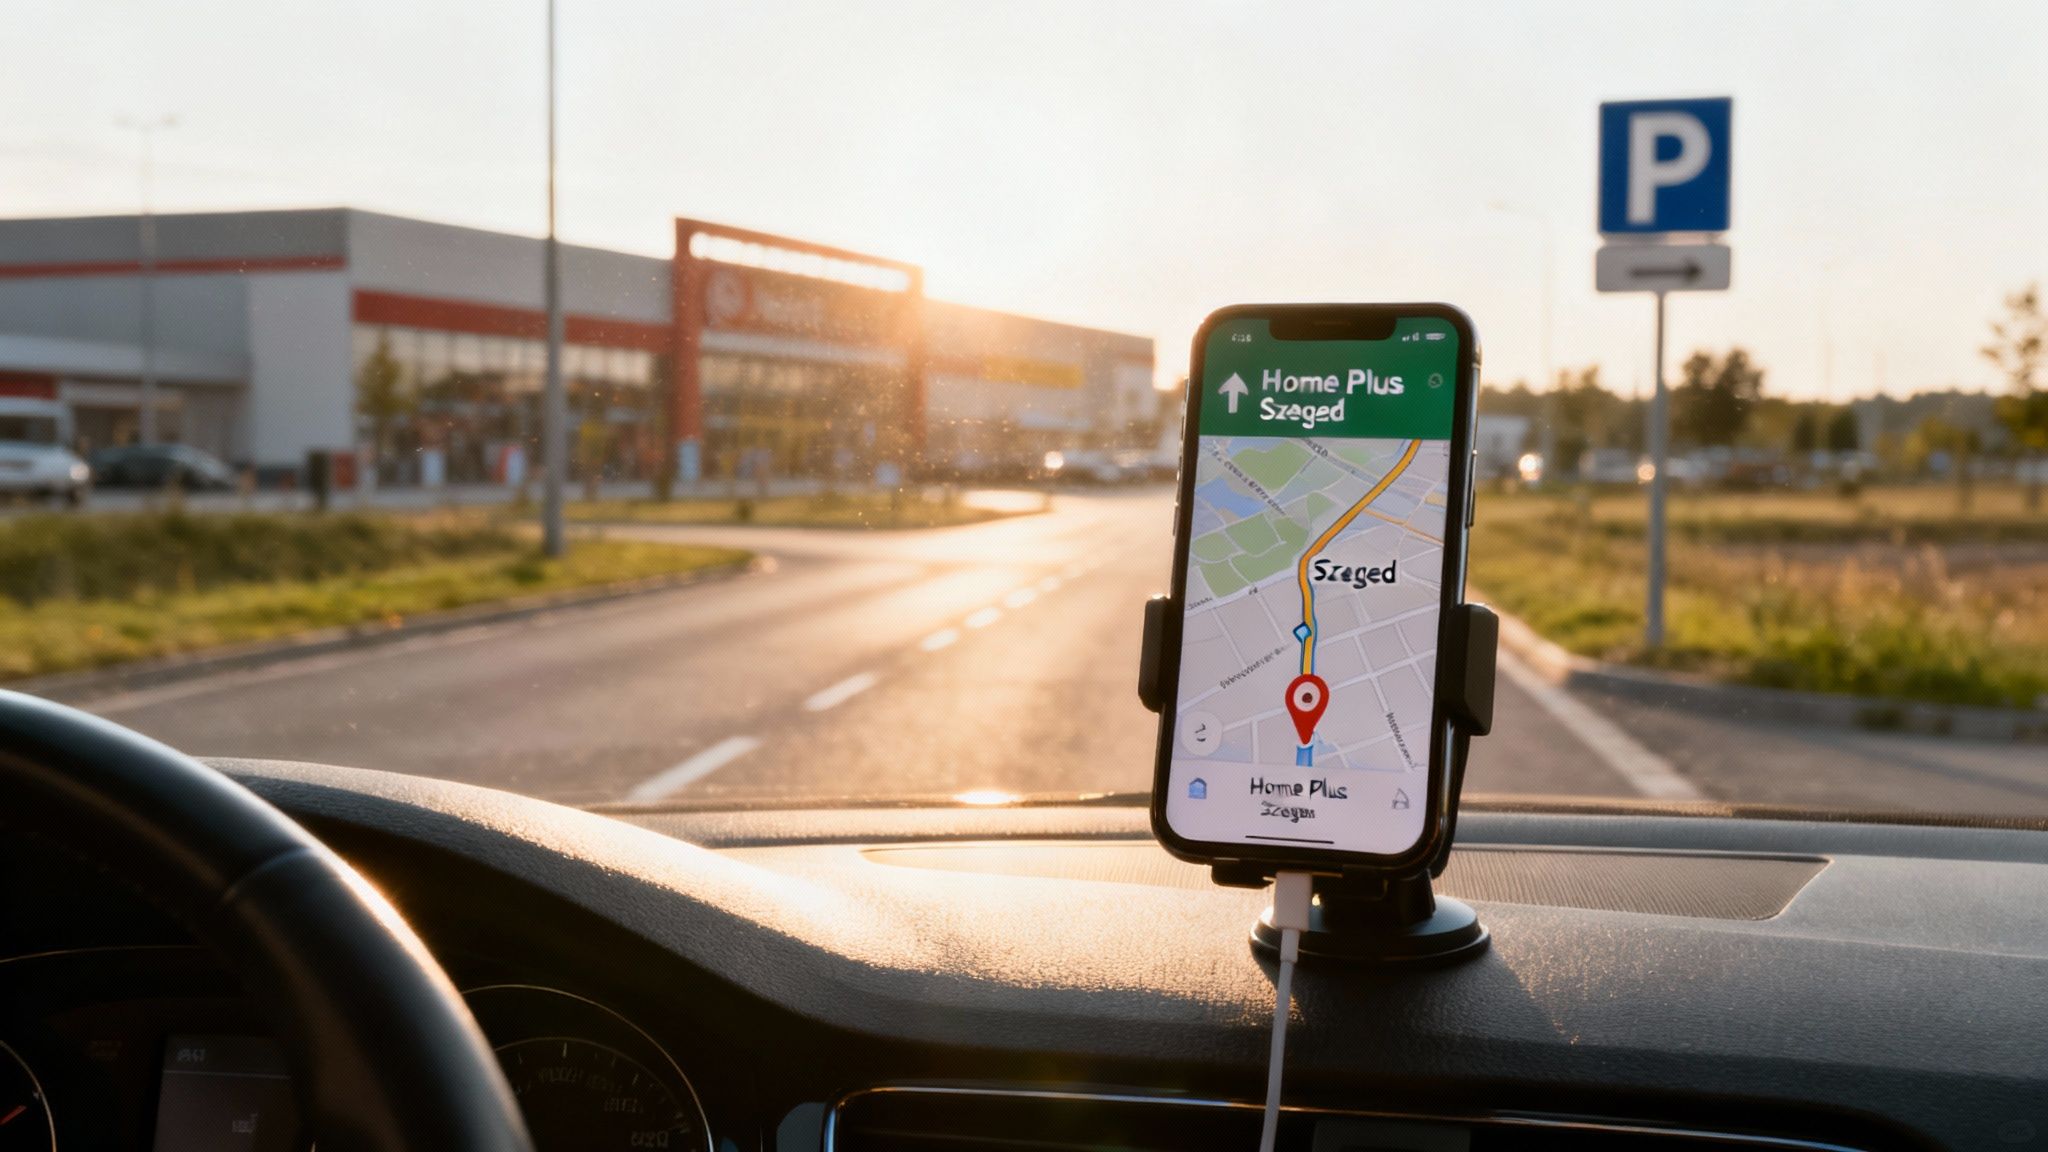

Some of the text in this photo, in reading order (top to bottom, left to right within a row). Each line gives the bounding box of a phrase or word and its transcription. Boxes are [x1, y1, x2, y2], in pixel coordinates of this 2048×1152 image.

[1626, 111, 1712, 226] P
[1262, 369, 1404, 395] Home Plus
[1260, 397, 1345, 429] Szeged
[1314, 559, 1397, 589] Szeged
[1250, 777, 1348, 800] Home Plus
